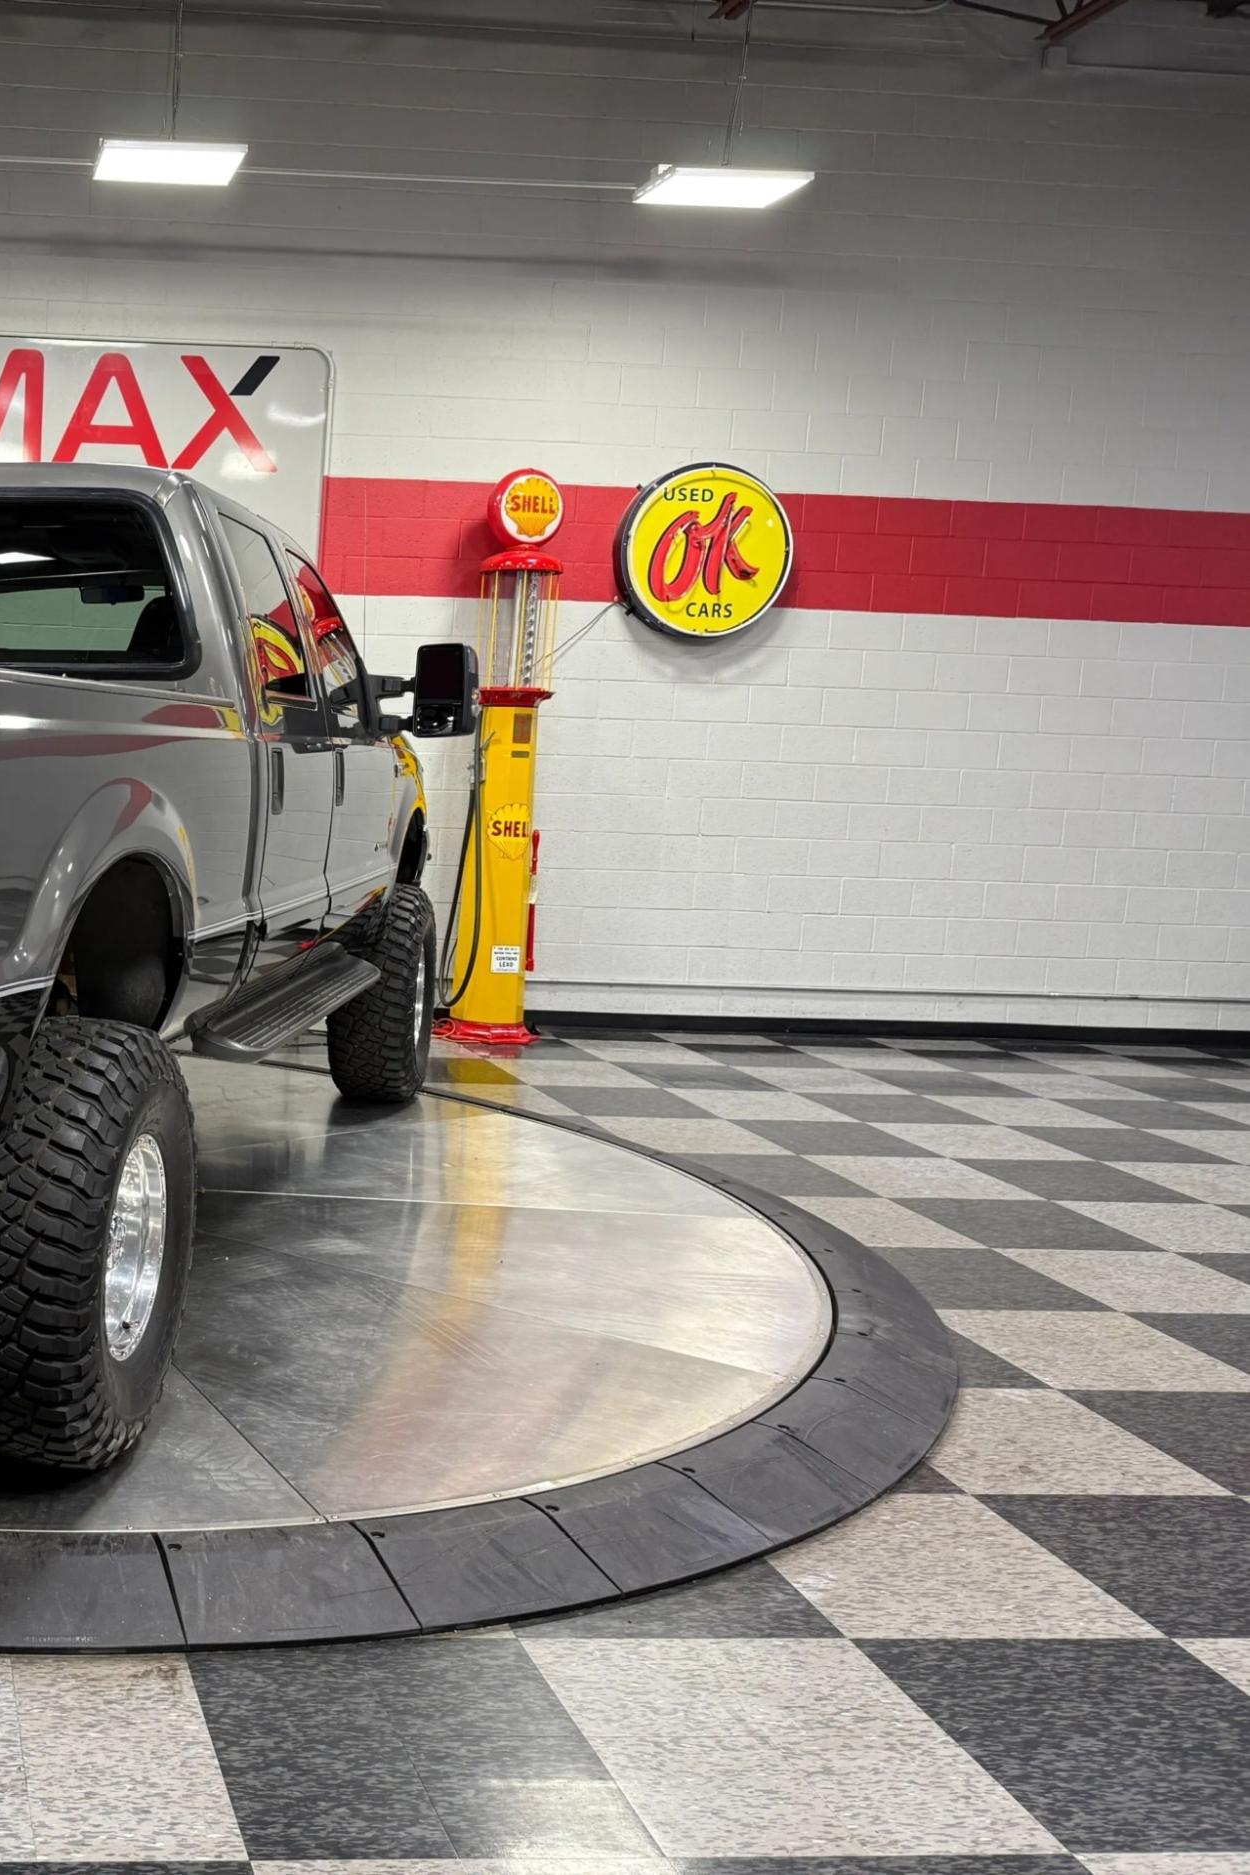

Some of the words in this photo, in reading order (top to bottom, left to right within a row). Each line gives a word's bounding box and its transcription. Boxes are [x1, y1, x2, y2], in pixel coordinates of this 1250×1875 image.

[663, 487, 715, 502] USED
[509, 494, 557, 515] SHELL
[647, 491, 760, 603] OK
[685, 602, 733, 619] CARS
